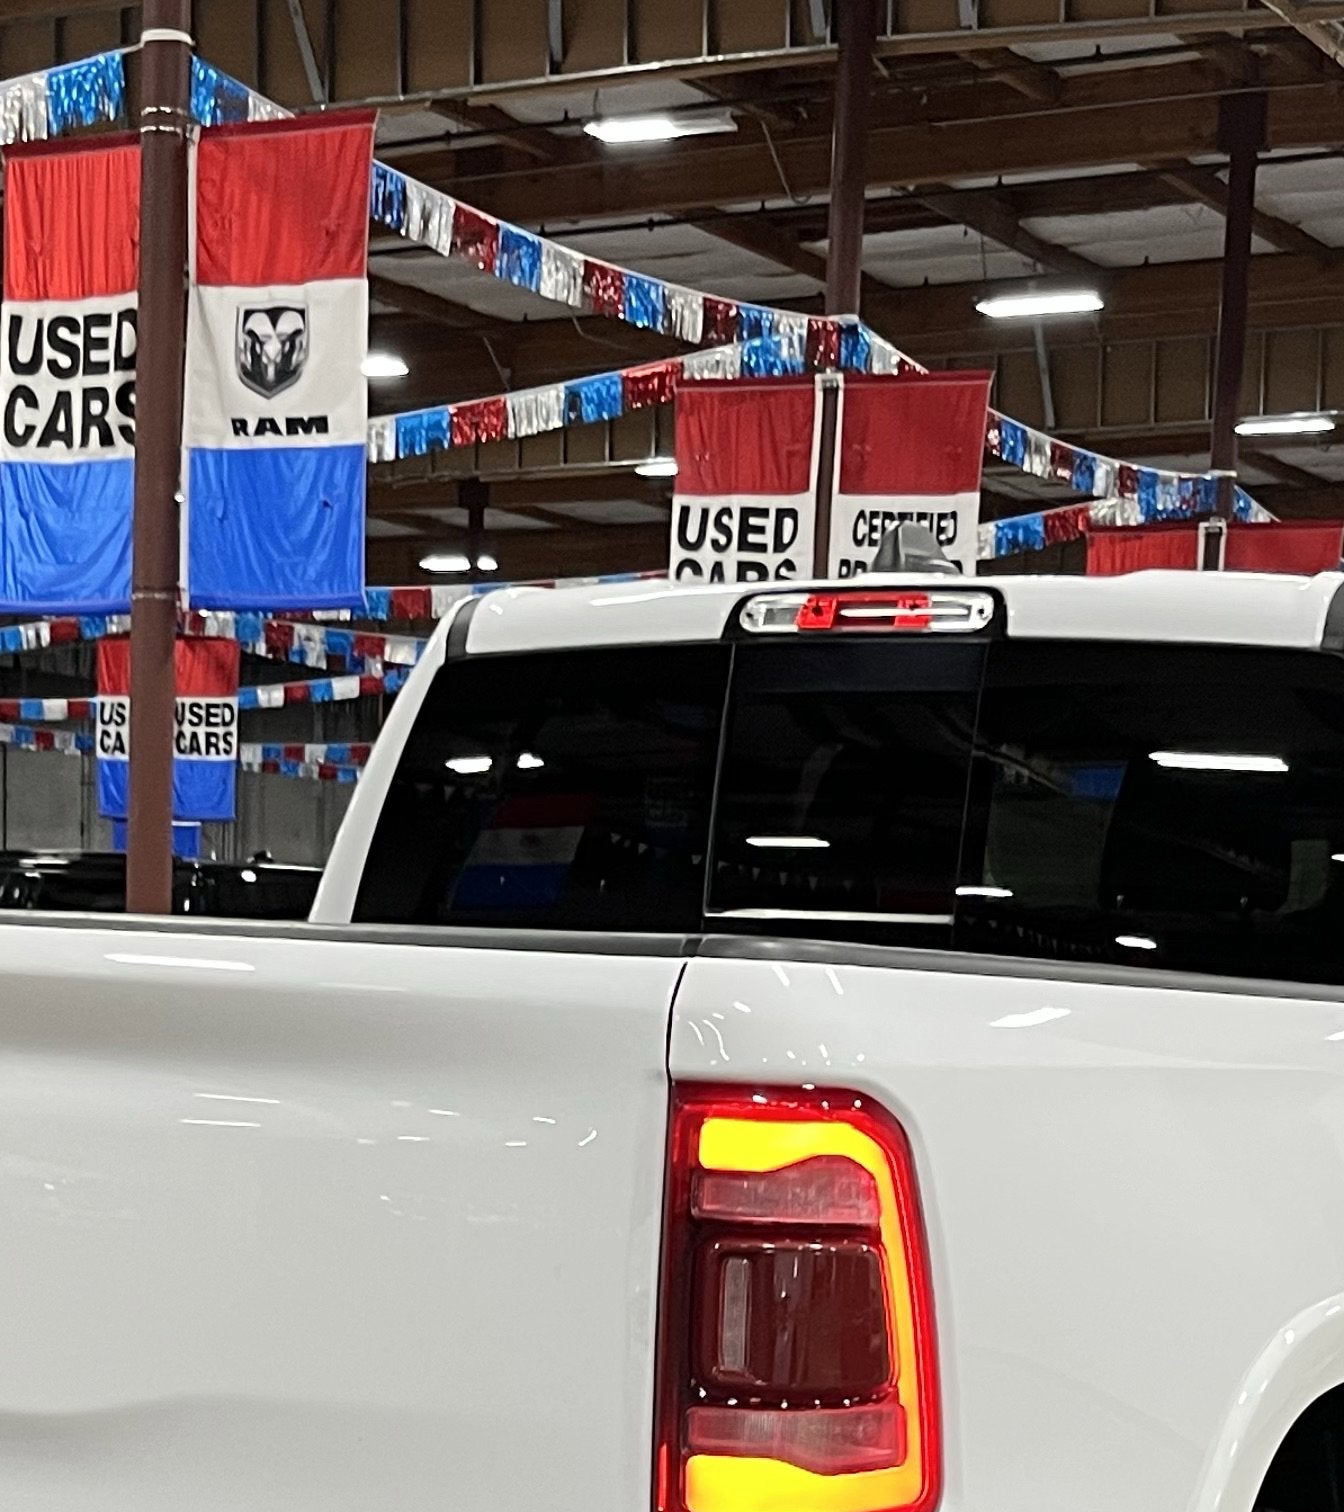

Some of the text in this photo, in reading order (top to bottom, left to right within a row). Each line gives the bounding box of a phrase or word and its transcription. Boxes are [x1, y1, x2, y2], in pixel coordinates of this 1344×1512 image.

[8, 308, 138, 379] USED
[4, 379, 137, 449] CARS
[231, 416, 329, 437] RAM
[677, 505, 799, 554] USED
[853, 509, 958, 547] CERIED
[174, 702, 235, 727] USED
[175, 731, 234, 756] CARS
